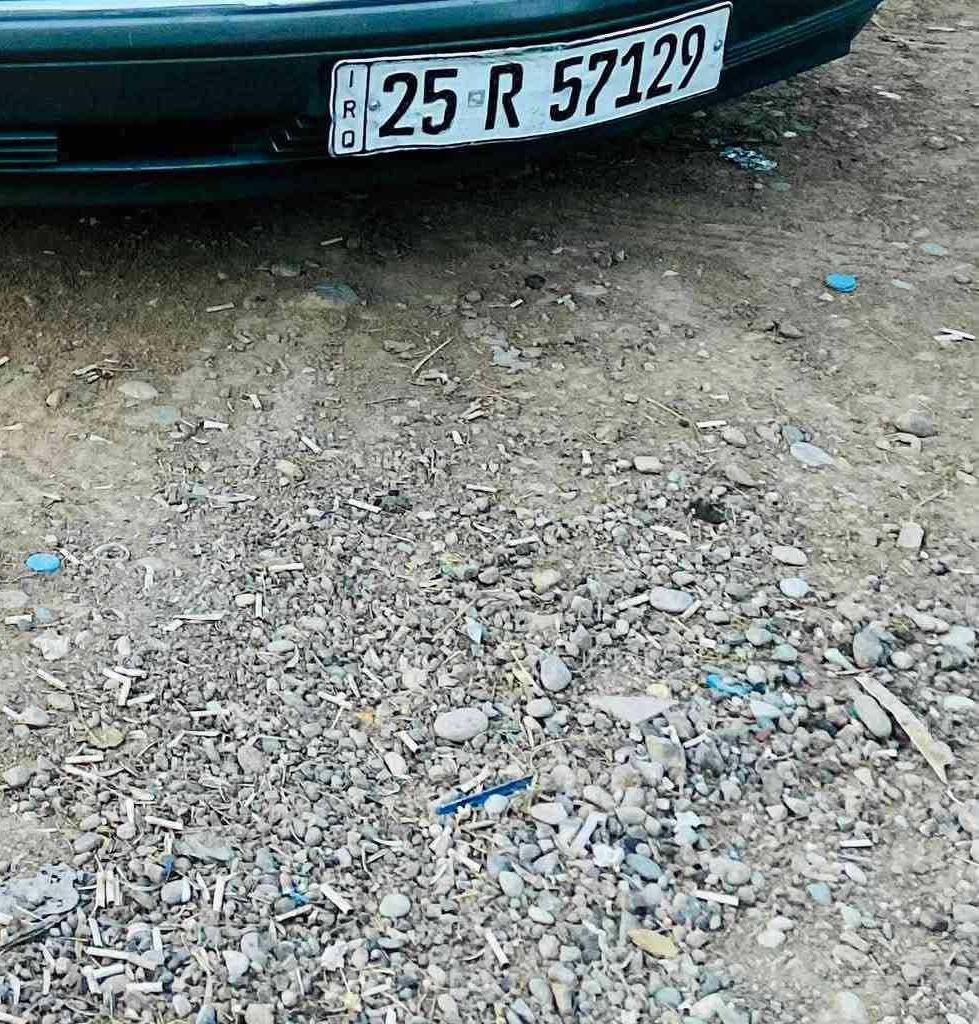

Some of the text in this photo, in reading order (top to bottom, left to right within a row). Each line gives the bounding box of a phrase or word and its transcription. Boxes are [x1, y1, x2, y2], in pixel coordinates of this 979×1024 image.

[378, 24, 707, 138] 25 R 57129
